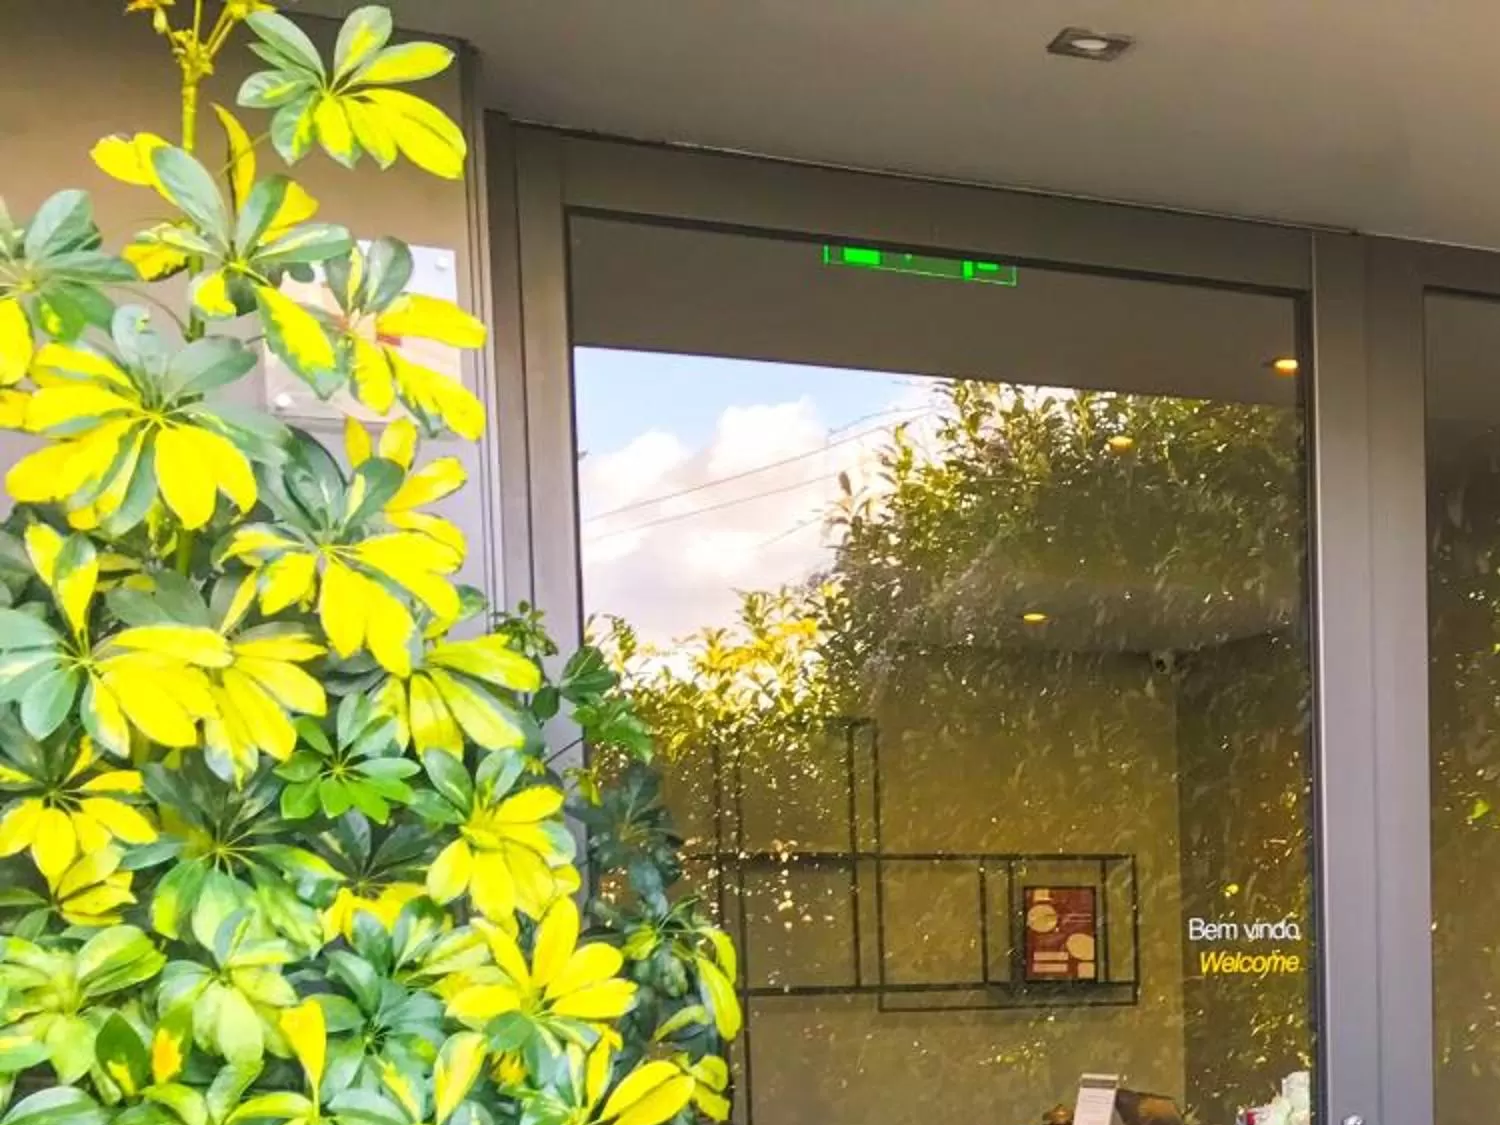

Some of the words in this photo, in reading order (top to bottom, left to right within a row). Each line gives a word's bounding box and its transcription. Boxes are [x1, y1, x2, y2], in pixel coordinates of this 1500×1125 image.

[1188, 917, 1239, 941] Bem
[1243, 917, 1300, 942] vindo
[1200, 951, 1300, 974] Welcome
